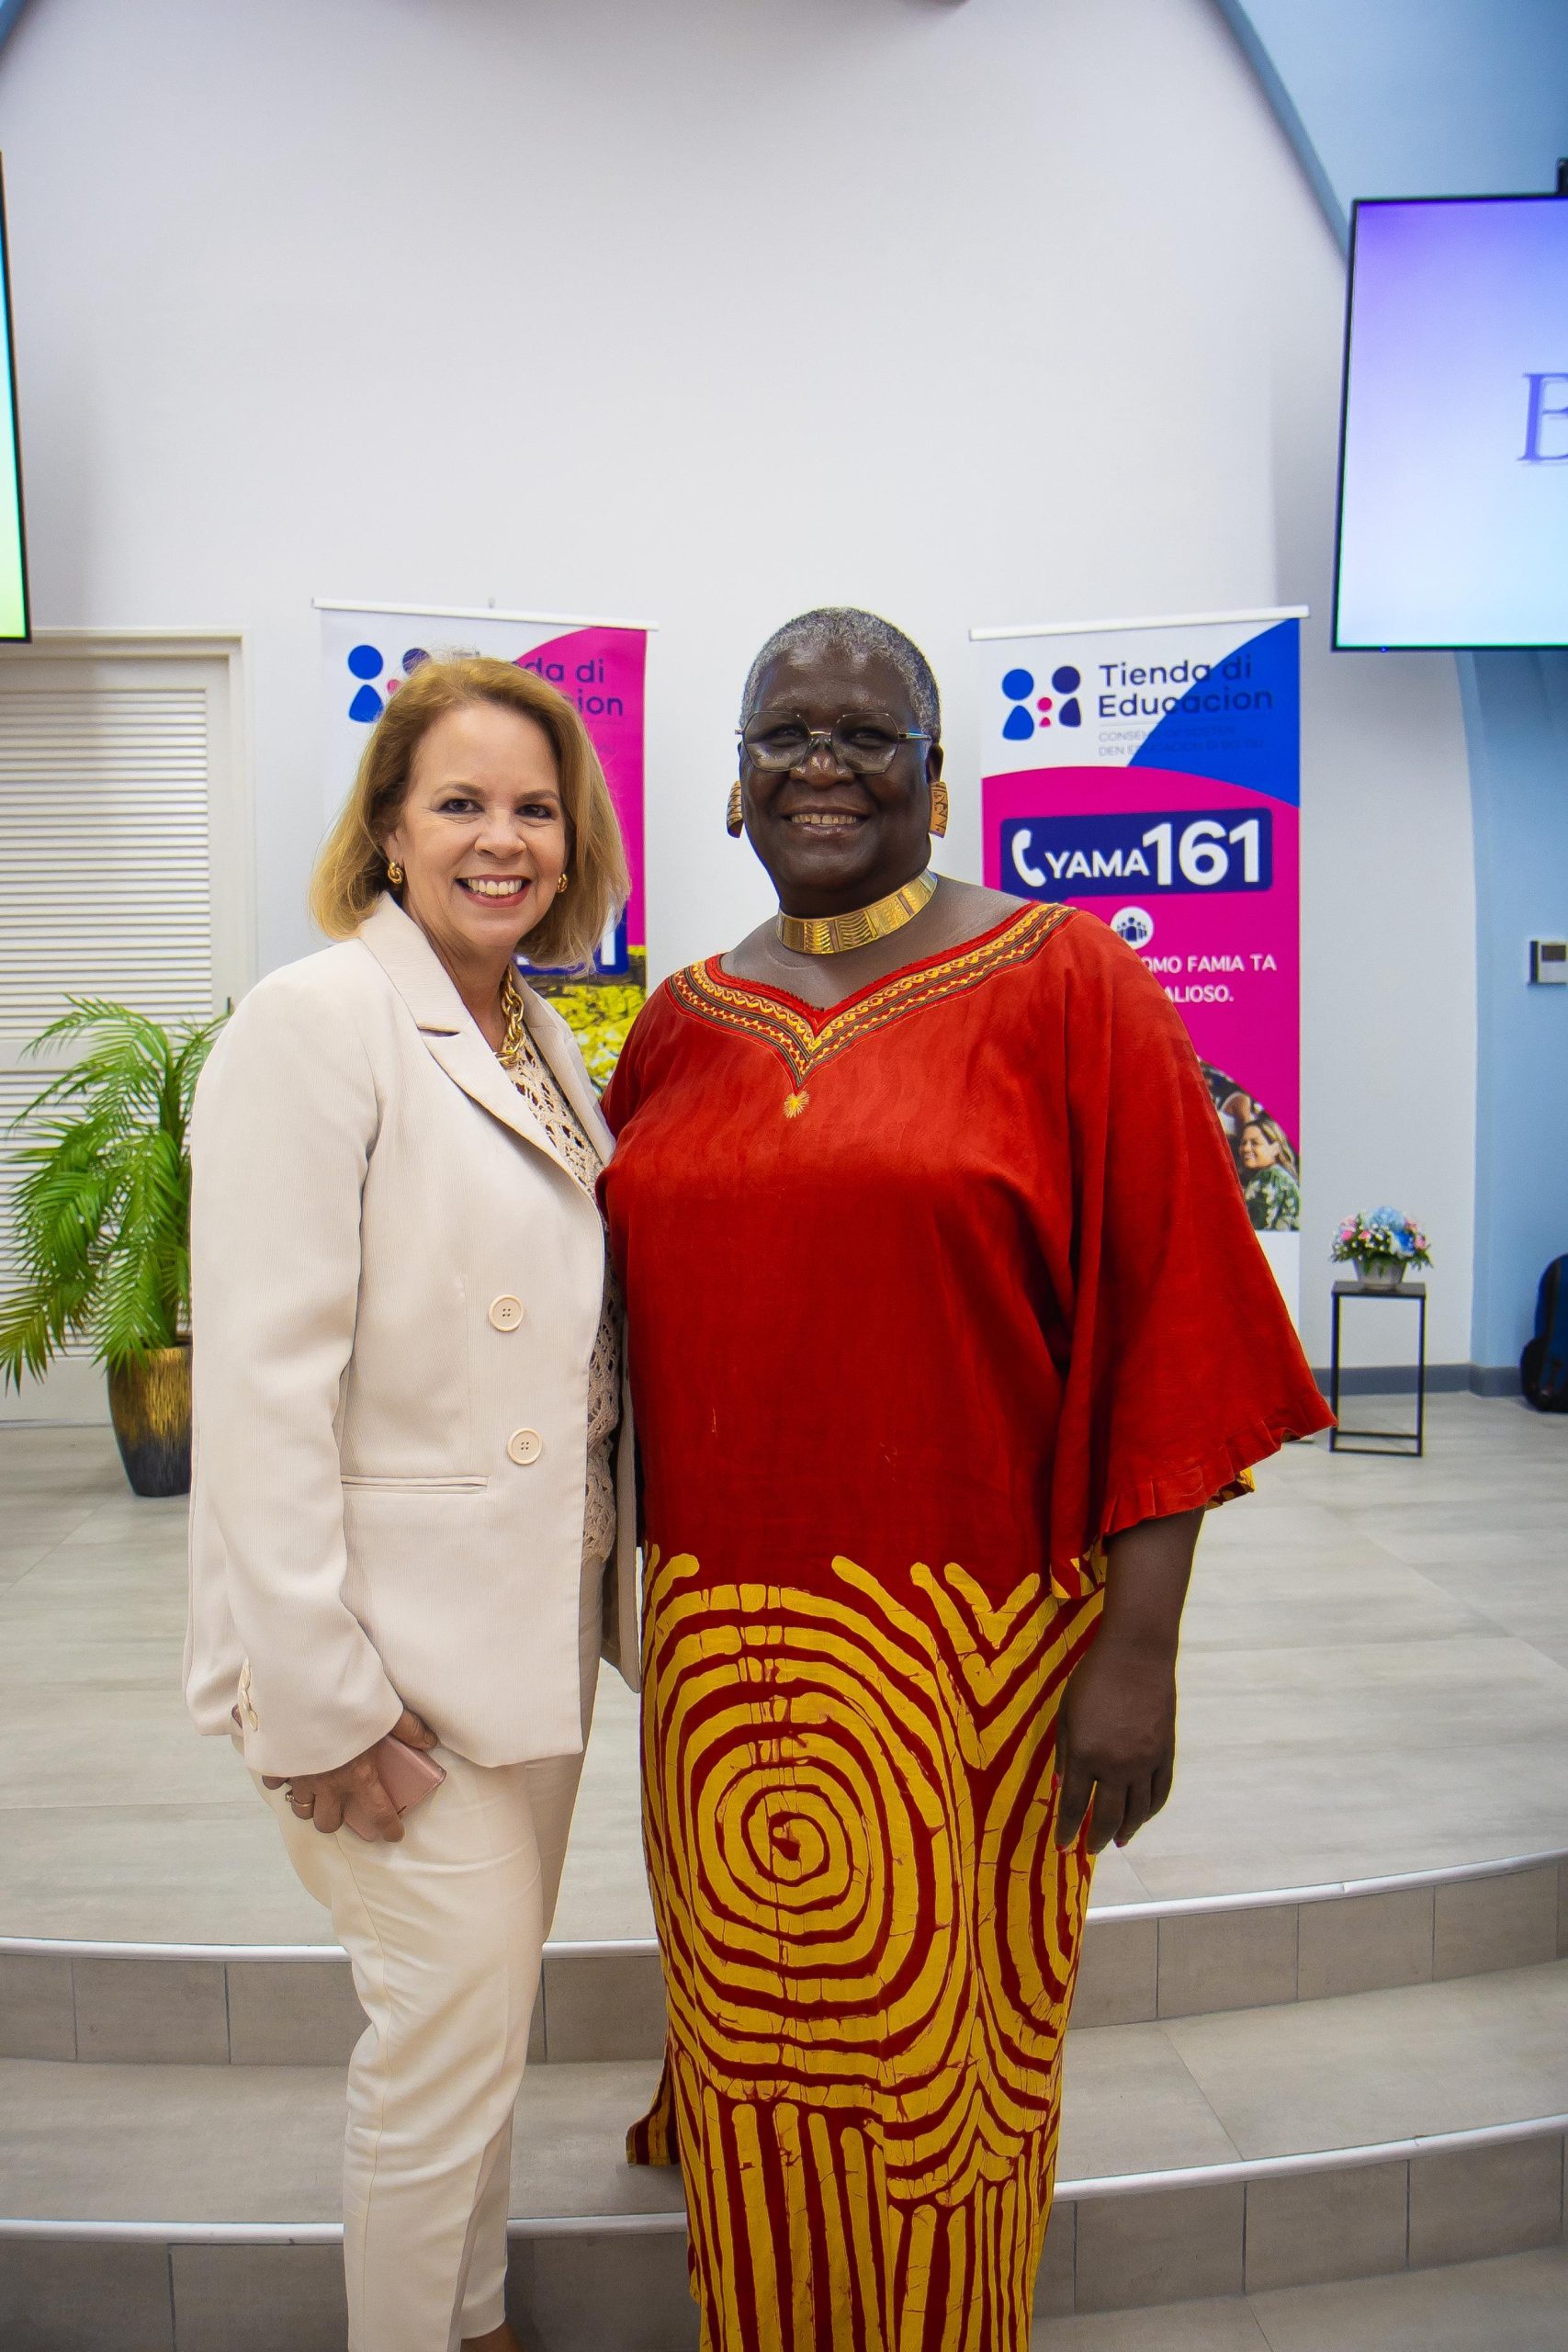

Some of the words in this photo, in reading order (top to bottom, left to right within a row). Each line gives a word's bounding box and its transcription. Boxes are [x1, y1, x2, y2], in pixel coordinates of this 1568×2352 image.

[576, 658, 604, 683] di
[1099, 660, 1212, 688] Tienda
[1223, 654, 1252, 680] di
[1099, 686, 1273, 718] Educacion
[1044, 847, 1150, 879] YAMA
[1142, 818, 1260, 886] 161
[1141, 955, 1183, 974] OMO
[1187, 954, 1246, 974] FAMIA
[1249, 952, 1278, 972] TA
[1164, 983, 1235, 1003] ALIOSO.
